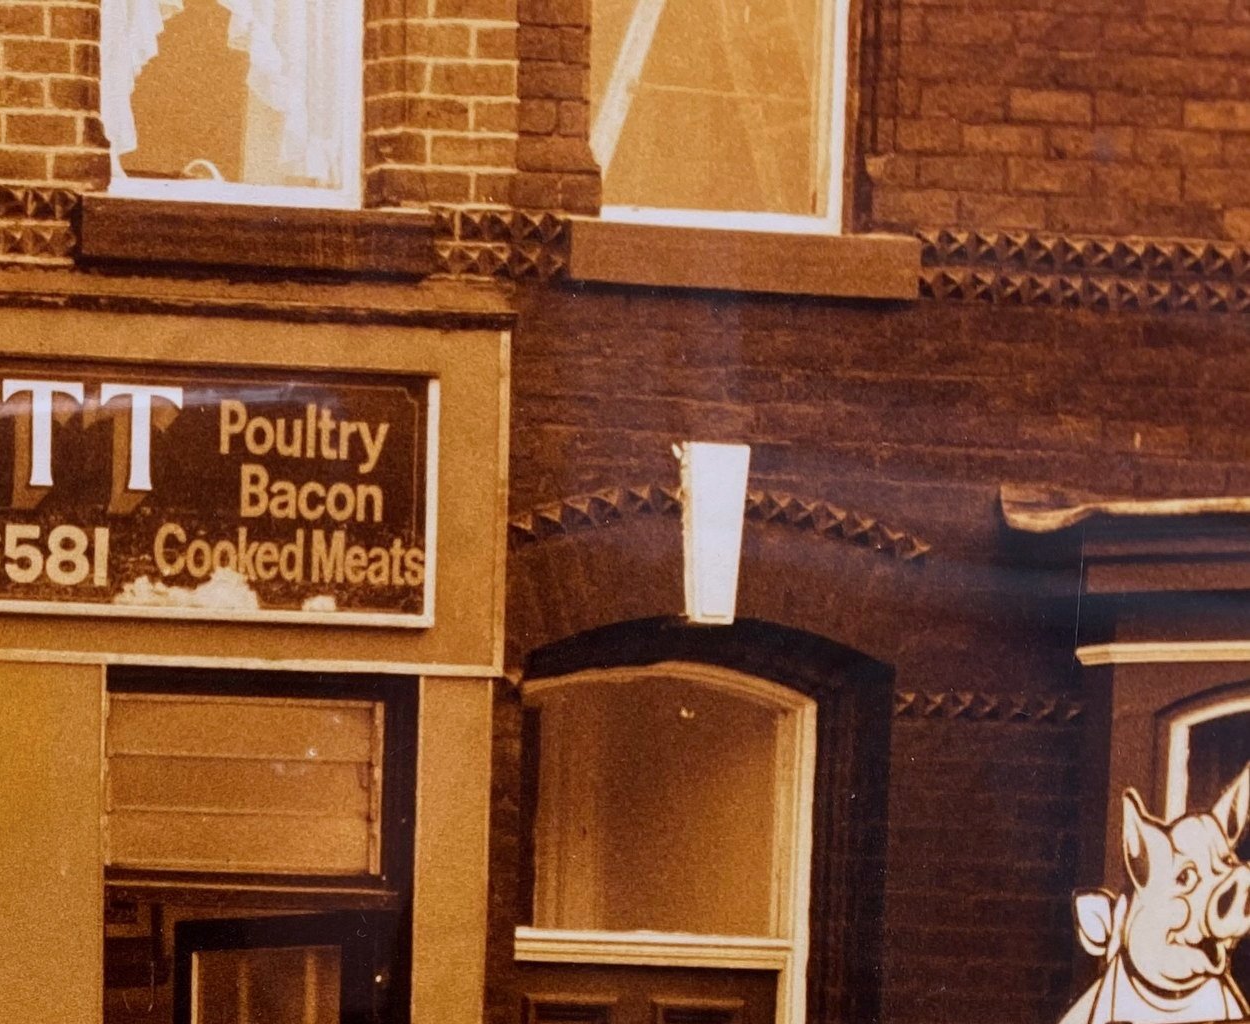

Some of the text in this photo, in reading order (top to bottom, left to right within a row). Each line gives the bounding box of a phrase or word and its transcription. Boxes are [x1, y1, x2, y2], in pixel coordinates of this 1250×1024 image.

[219, 399, 389, 474] Poultry
[239, 470, 383, 524] Bacon
[153, 522, 426, 587] Cooked Meats
